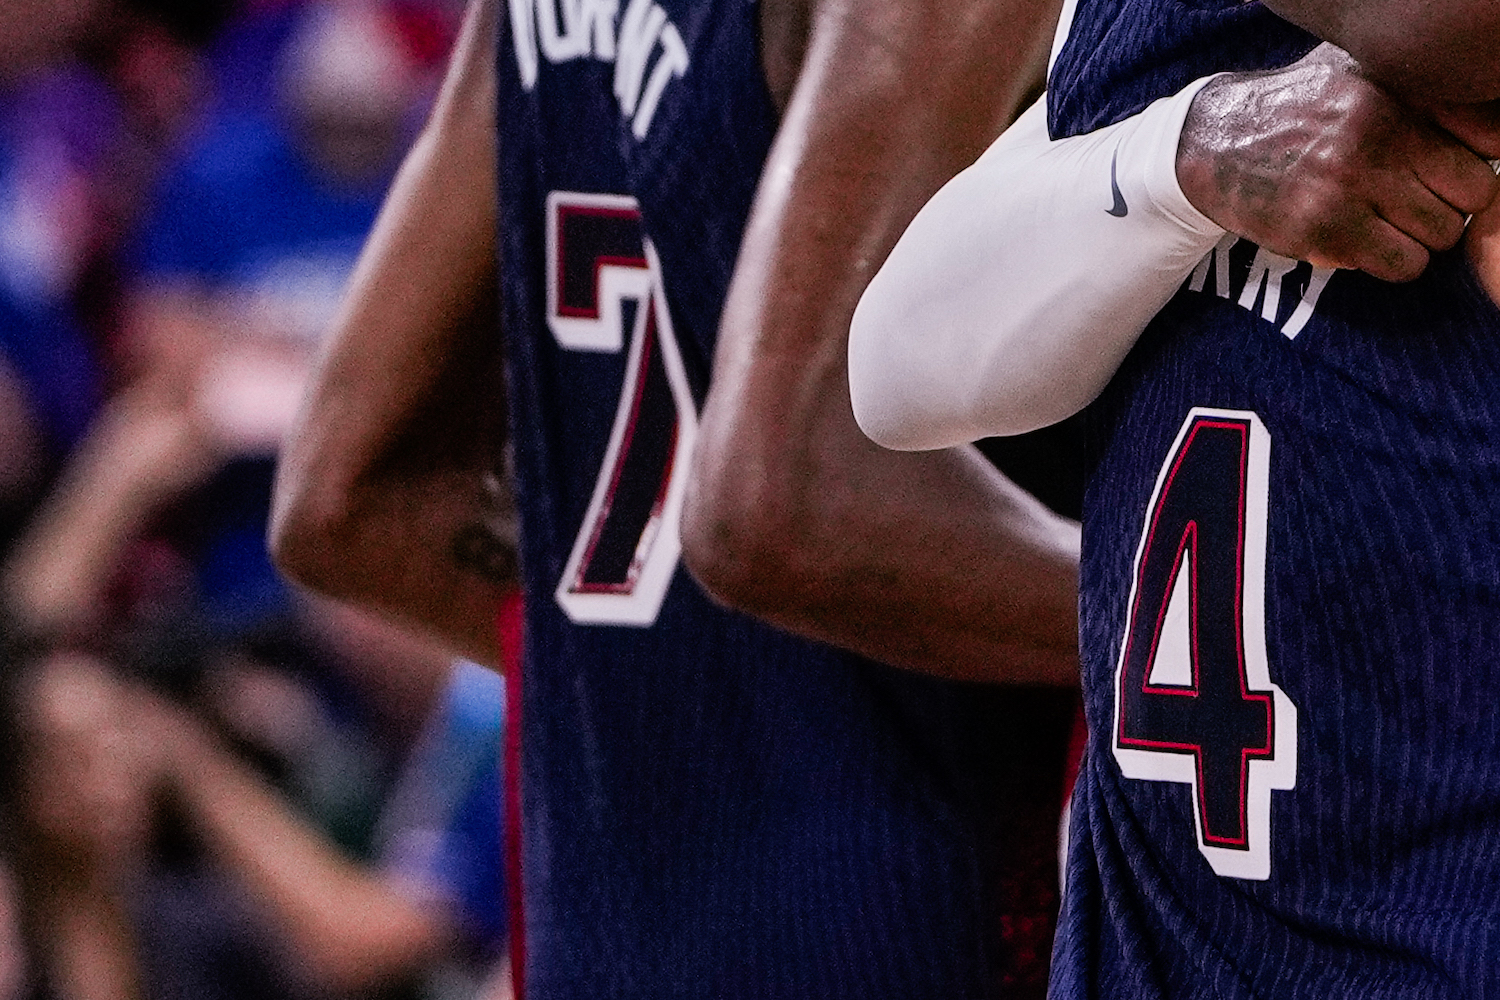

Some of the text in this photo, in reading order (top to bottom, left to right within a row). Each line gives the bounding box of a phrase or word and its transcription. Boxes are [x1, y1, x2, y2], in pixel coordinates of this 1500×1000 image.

[545, 189, 699, 627] 7
[1187, 231, 1338, 341] RRY
[1111, 406, 1298, 881] 4
